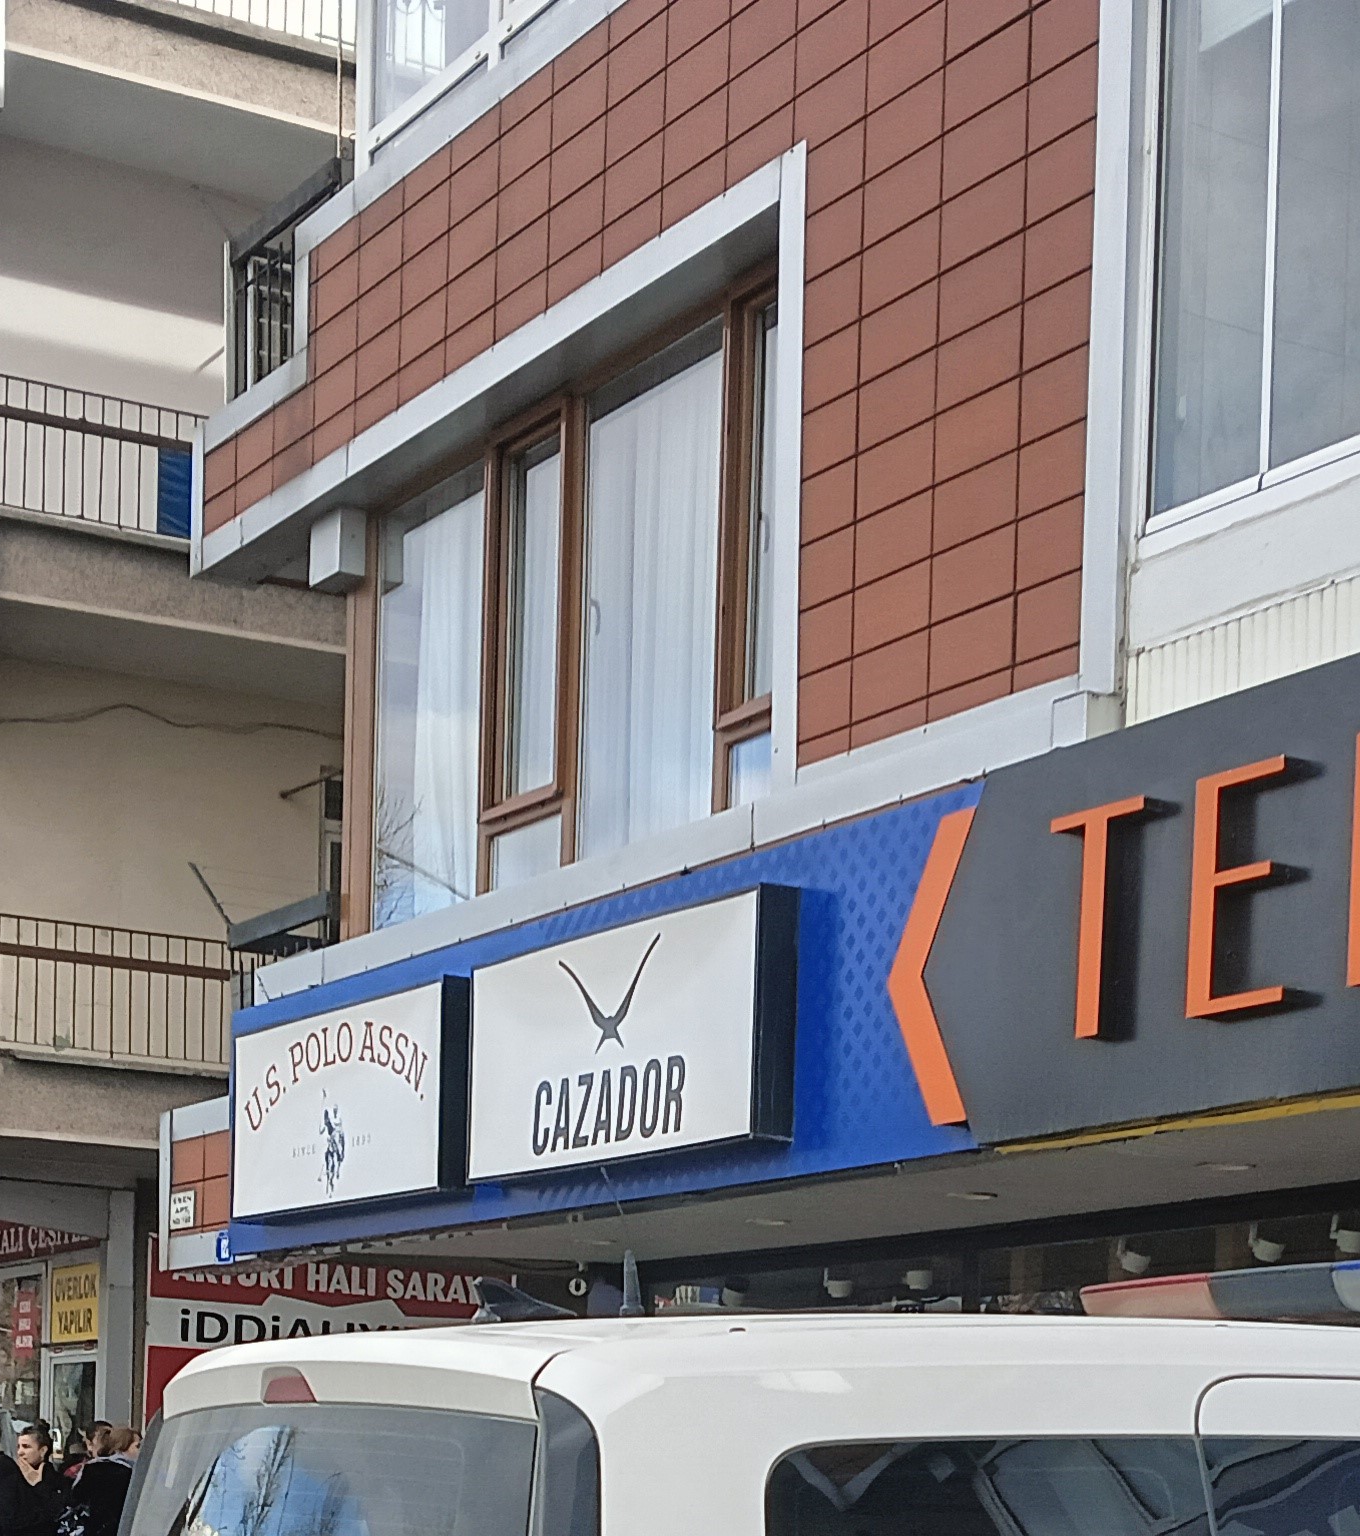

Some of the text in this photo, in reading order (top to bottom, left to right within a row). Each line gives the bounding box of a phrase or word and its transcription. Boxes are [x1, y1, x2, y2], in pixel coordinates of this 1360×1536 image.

[244, 1064, 287, 1131] U.S.
[288, 1022, 353, 1085] POLO
[532, 1055, 686, 1156] CAZADOR
[54, 1274, 97, 1303] OVERLOK
[306, 1262, 376, 1298] HALI
[57, 1308, 93, 1335] YAPILIR
